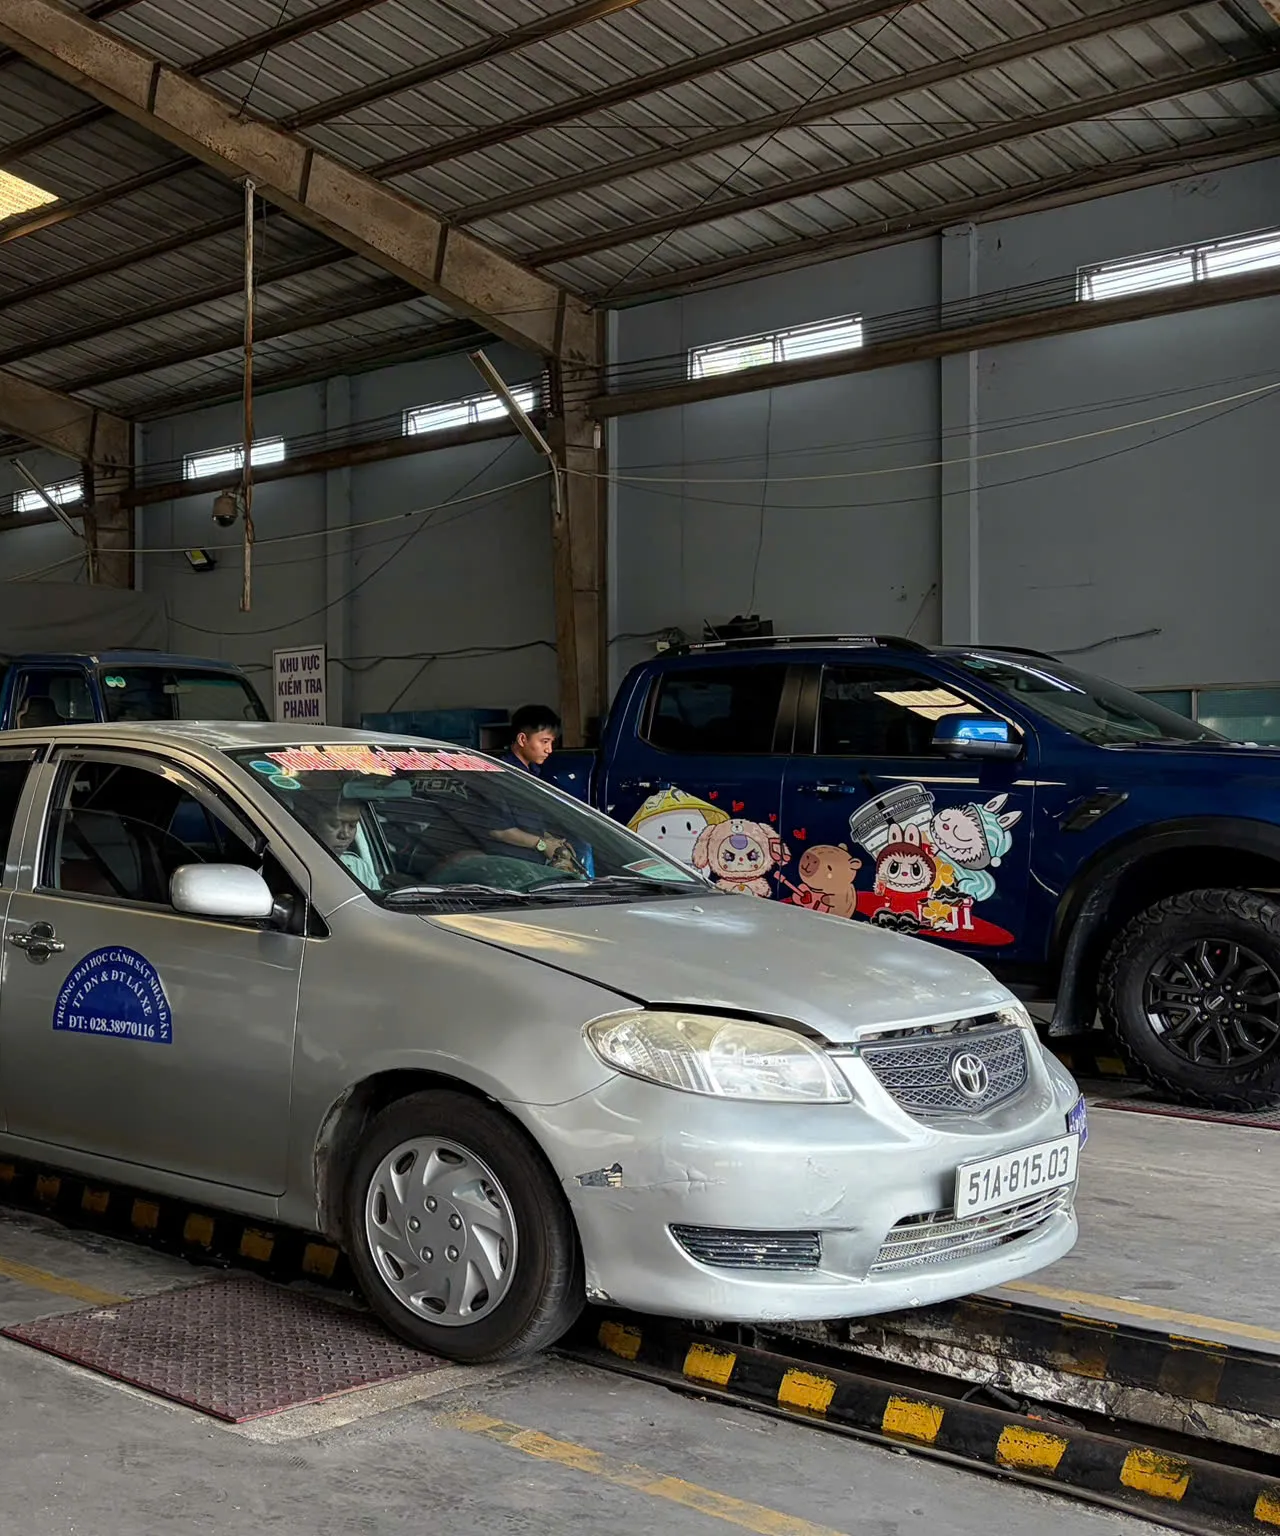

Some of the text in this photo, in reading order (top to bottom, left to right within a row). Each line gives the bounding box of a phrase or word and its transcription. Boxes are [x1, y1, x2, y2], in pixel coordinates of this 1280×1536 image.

[280, 654, 320, 674] KHU VỰC
[278, 674, 323, 696] KIỂM TRA
[283, 698, 320, 719] PHANH
[57, 980, 76, 1026] TRƯỜNG
[89, 953, 109, 968] HỌC
[109, 949, 135, 966] CẢNH
[134, 960, 151, 979] SÁT
[148, 977, 166, 1010] NHÂN
[159, 1011, 170, 1039] DÂN
[72, 969, 153, 1017] TT DN & ĐT LÁI XE
[68, 1015, 155, 1038] ĐT: 028.38970116
[967, 1145, 1069, 1206] 51A-815.03
